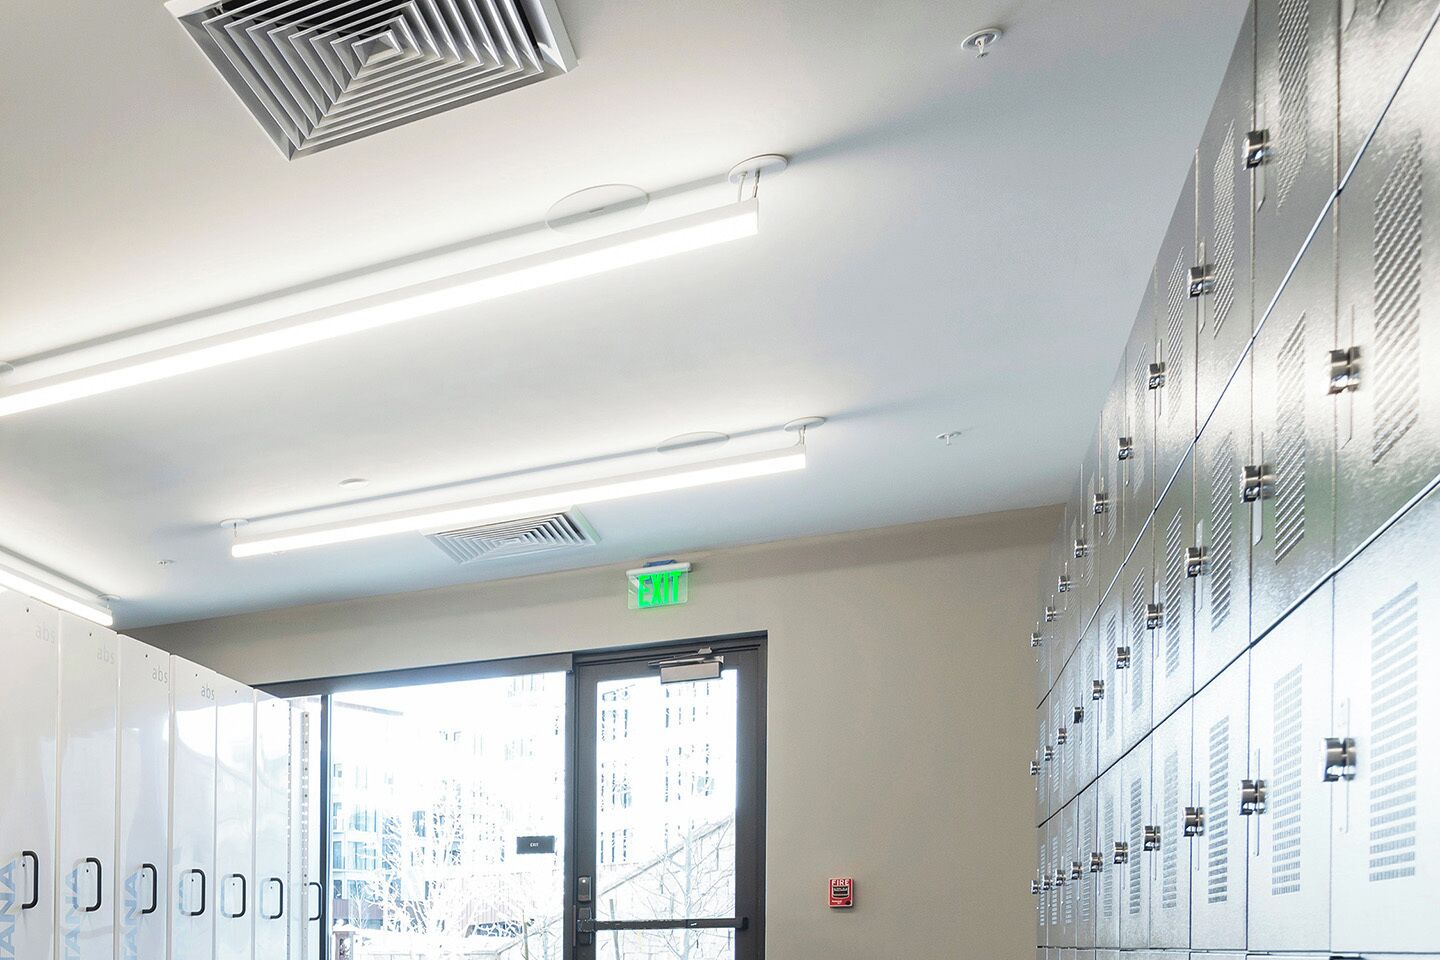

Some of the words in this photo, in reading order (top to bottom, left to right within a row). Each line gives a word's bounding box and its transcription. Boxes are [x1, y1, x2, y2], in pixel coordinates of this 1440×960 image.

[637, 570, 682, 608] EXIT
[35, 621, 56, 644] abs
[97, 645, 115, 665] abs
[151, 666, 168, 684] abs
[201, 684, 215, 701] abs
